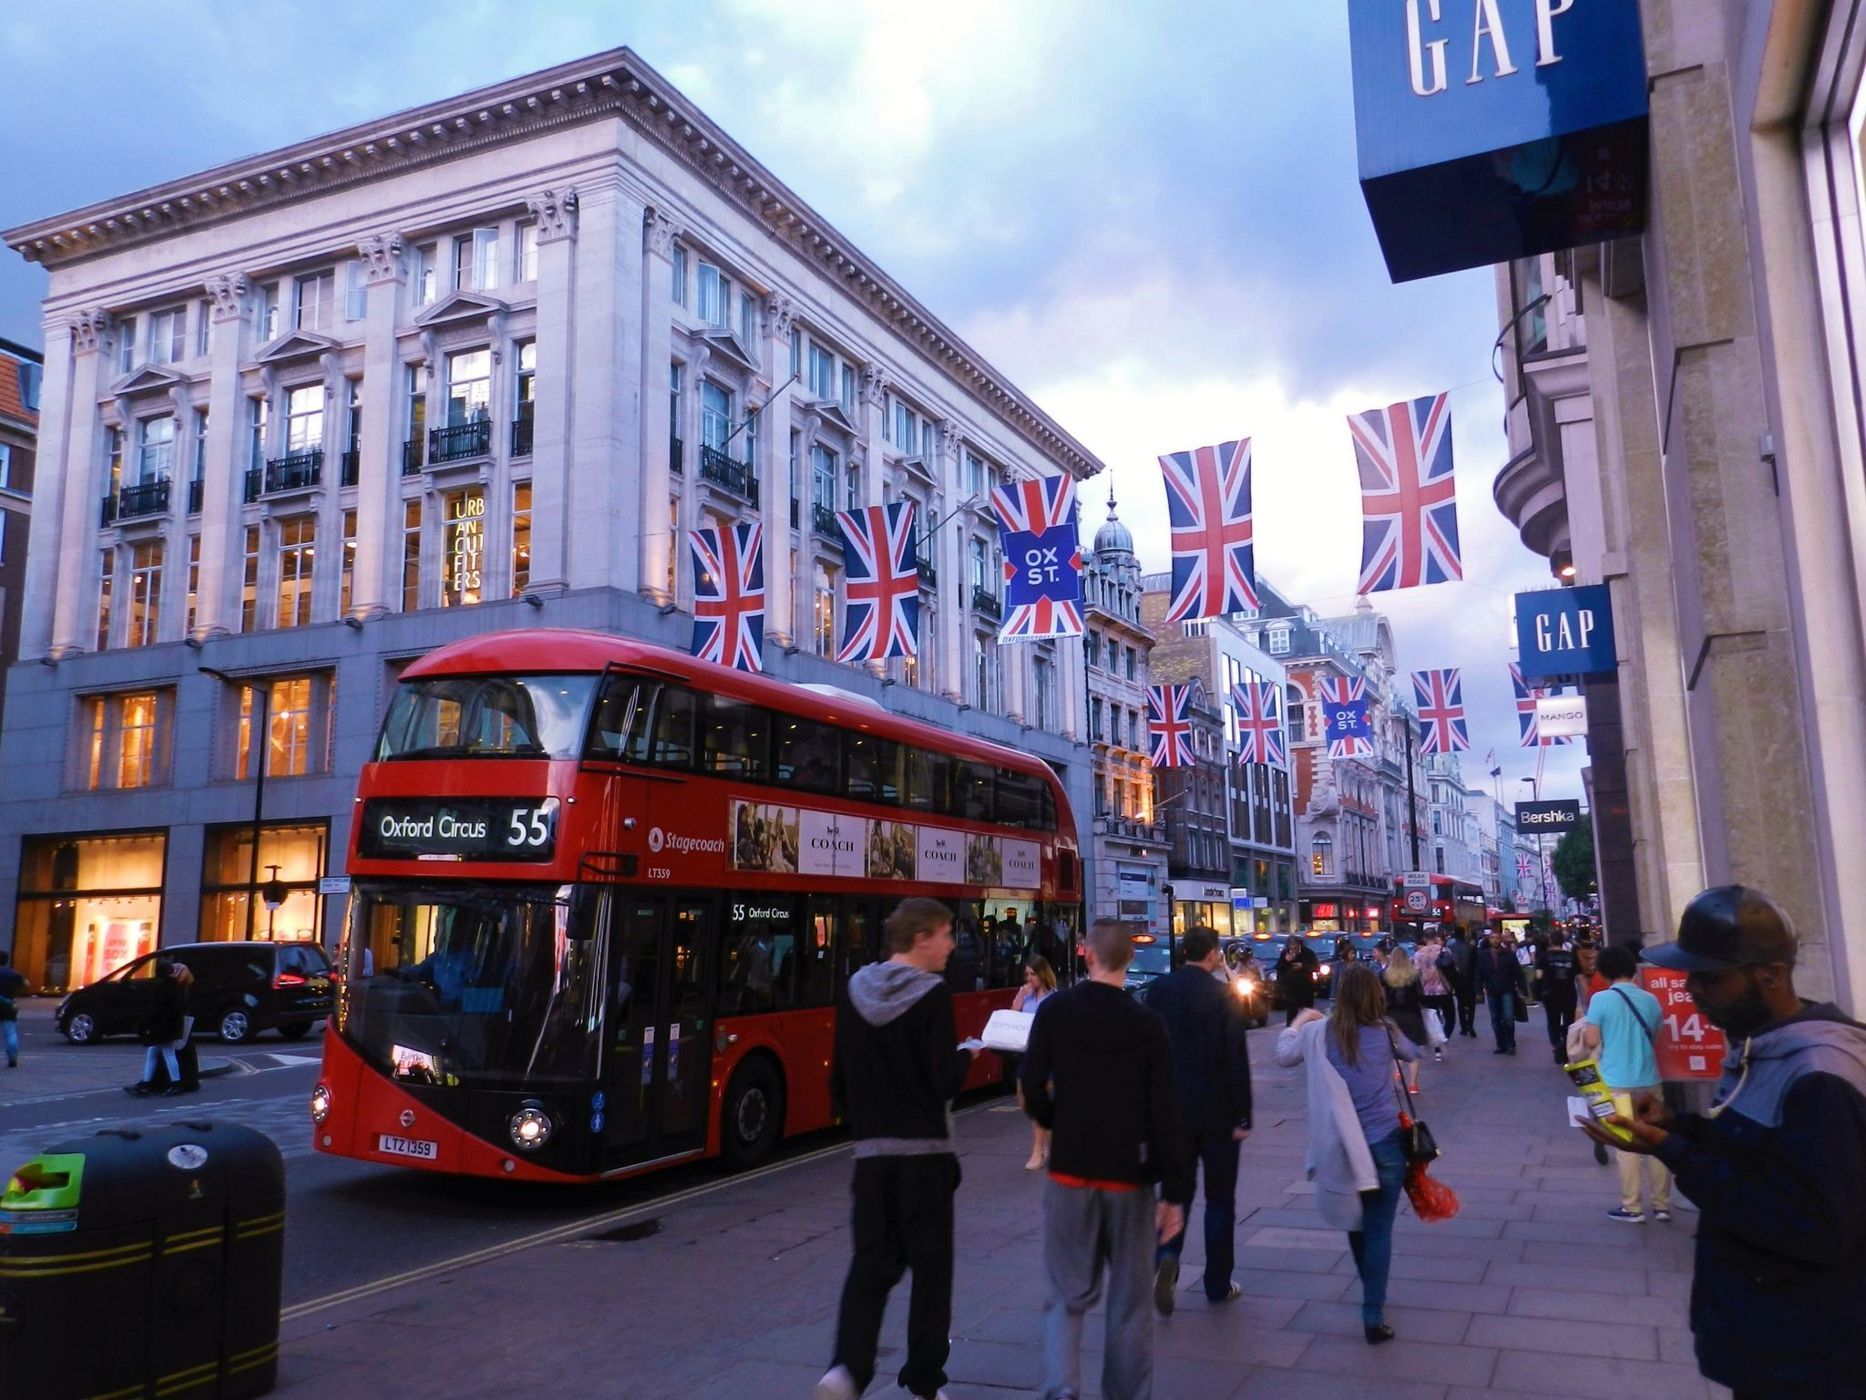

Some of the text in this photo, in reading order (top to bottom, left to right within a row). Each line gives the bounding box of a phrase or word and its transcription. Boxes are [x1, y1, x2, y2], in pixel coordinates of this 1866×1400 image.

[1405, 0, 1574, 97] GAP
[456, 498, 485, 518] URB
[456, 520, 477, 536] AN
[1025, 546, 1058, 567] OX
[1028, 565, 1060, 586] ST.
[1535, 609, 1594, 652] GAP
[1336, 711, 1357, 720] OX
[1541, 711, 1584, 721] MANGO
[1338, 720, 1358, 730] ST.
[1521, 810, 1575, 824] Bershka
[381, 808, 548, 847] Oxford Circus 55
[665, 832, 725, 854] Stagecoach
[811, 838, 854, 852] COACH
[925, 850, 957, 862] COACH
[1009, 860, 1034, 870] COACH
[648, 868, 671, 879] LT359
[732, 904, 789, 921] 55 Oxford Circus
[1651, 977, 1686, 989] all sa
[1668, 988, 1693, 1006] jea
